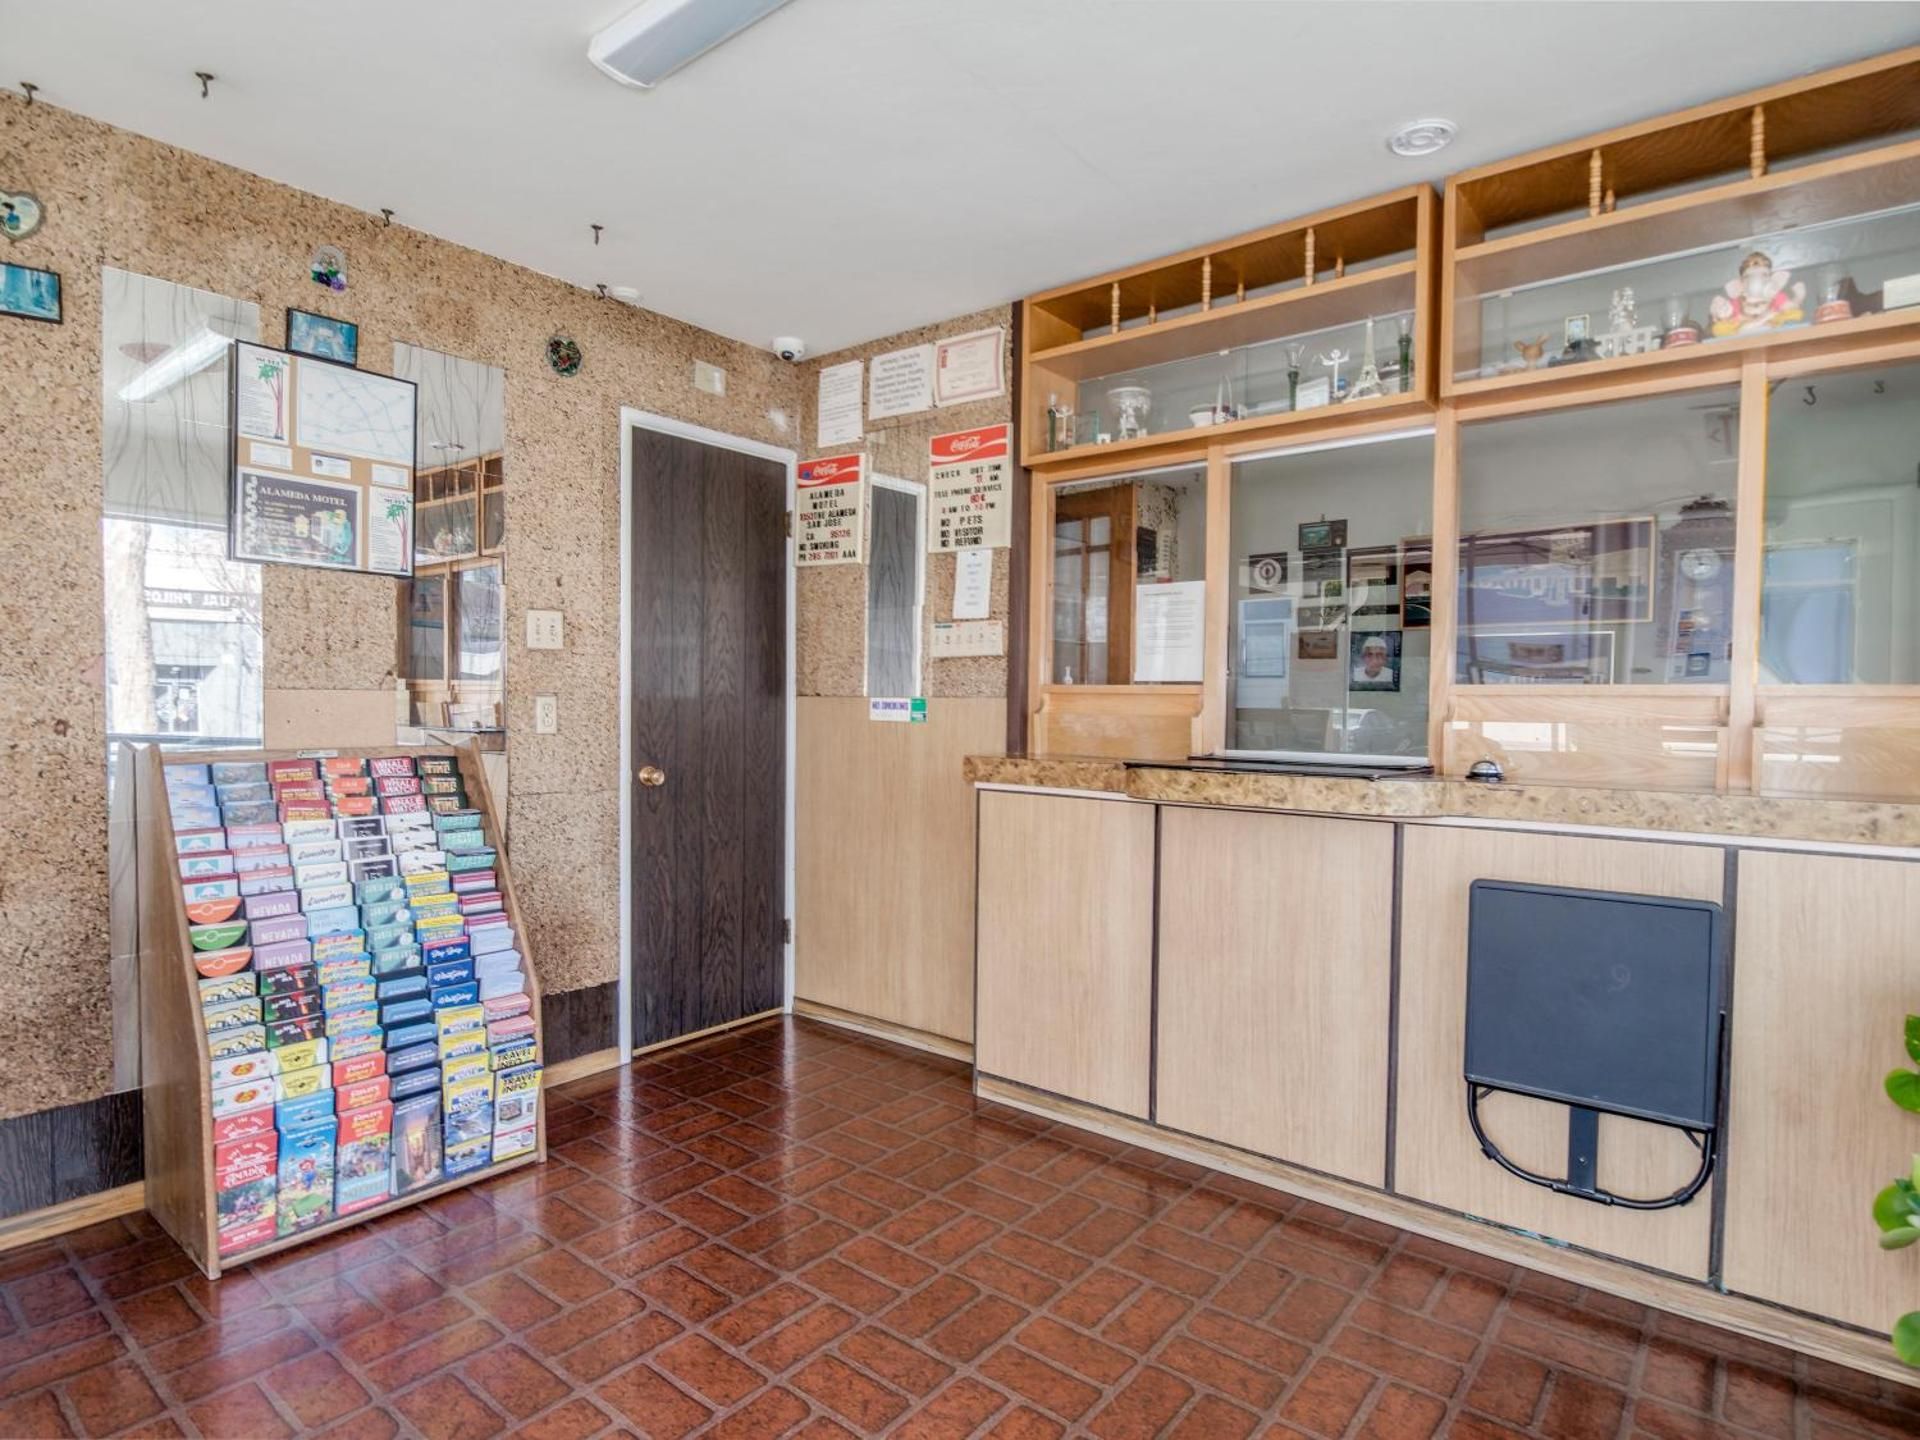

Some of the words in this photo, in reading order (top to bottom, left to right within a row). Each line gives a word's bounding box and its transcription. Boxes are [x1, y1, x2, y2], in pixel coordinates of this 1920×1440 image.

[260, 487, 311, 501] ALAMEDA
[312, 494, 348, 506] MOTEL
[809, 488, 844, 500] ALAMEDA
[813, 500, 838, 510] MOTEL
[807, 520, 820, 530] SAN
[960, 515, 983, 525] PETS
[810, 541, 839, 551] SMOKING
[253, 903, 291, 914] NEVADA
[261, 928, 300, 940] NEVADA
[265, 953, 304, 967] NEVADA
[498, 1048, 531, 1061] TRAVEL
[503, 1071, 537, 1085] TRAVEL
[502, 1082, 527, 1094] INFO
